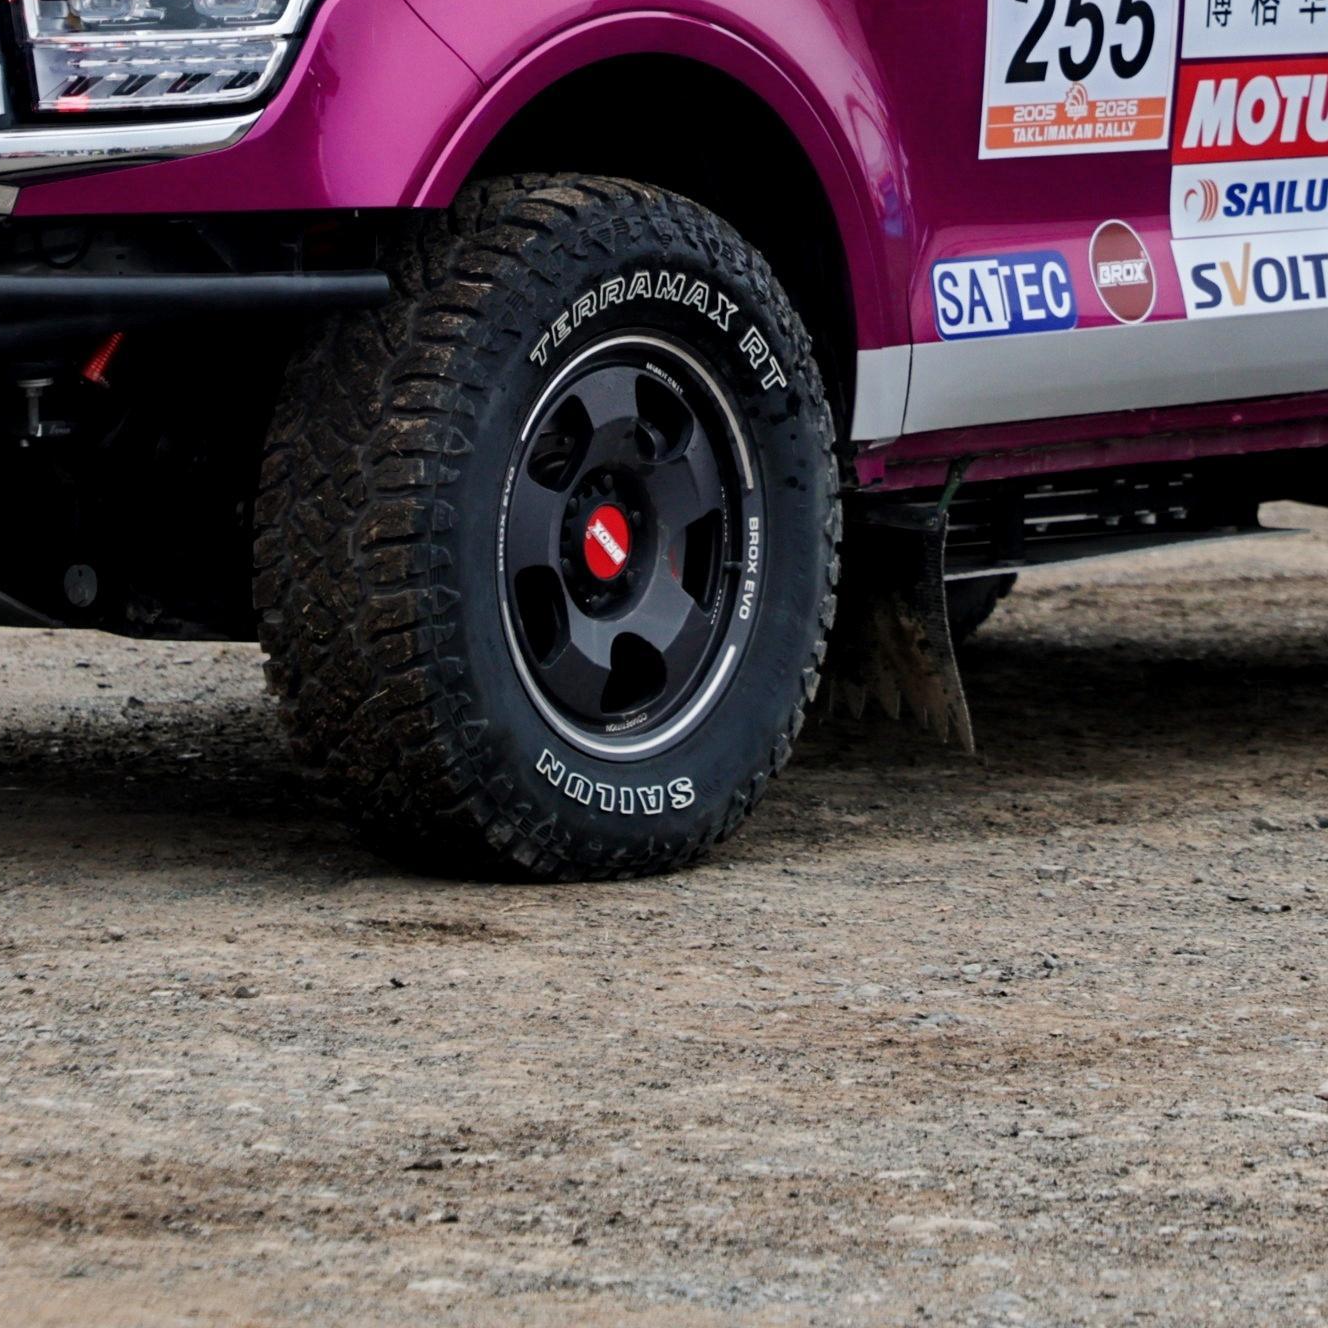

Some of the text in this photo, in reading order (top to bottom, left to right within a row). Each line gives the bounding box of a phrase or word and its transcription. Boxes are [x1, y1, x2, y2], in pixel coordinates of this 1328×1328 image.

[1012, 121, 1136, 143] TAKLIMAKAN RALLY
[1013, 101, 1138, 122] 2005 2026
[938, 261, 1071, 328] SATEC
[1098, 261, 1147, 286] BROX
[529, 271, 787, 390] TERRAMAX RT
[739, 517, 760, 620] BROX EVO
[536, 748, 695, 815] SAILUN
